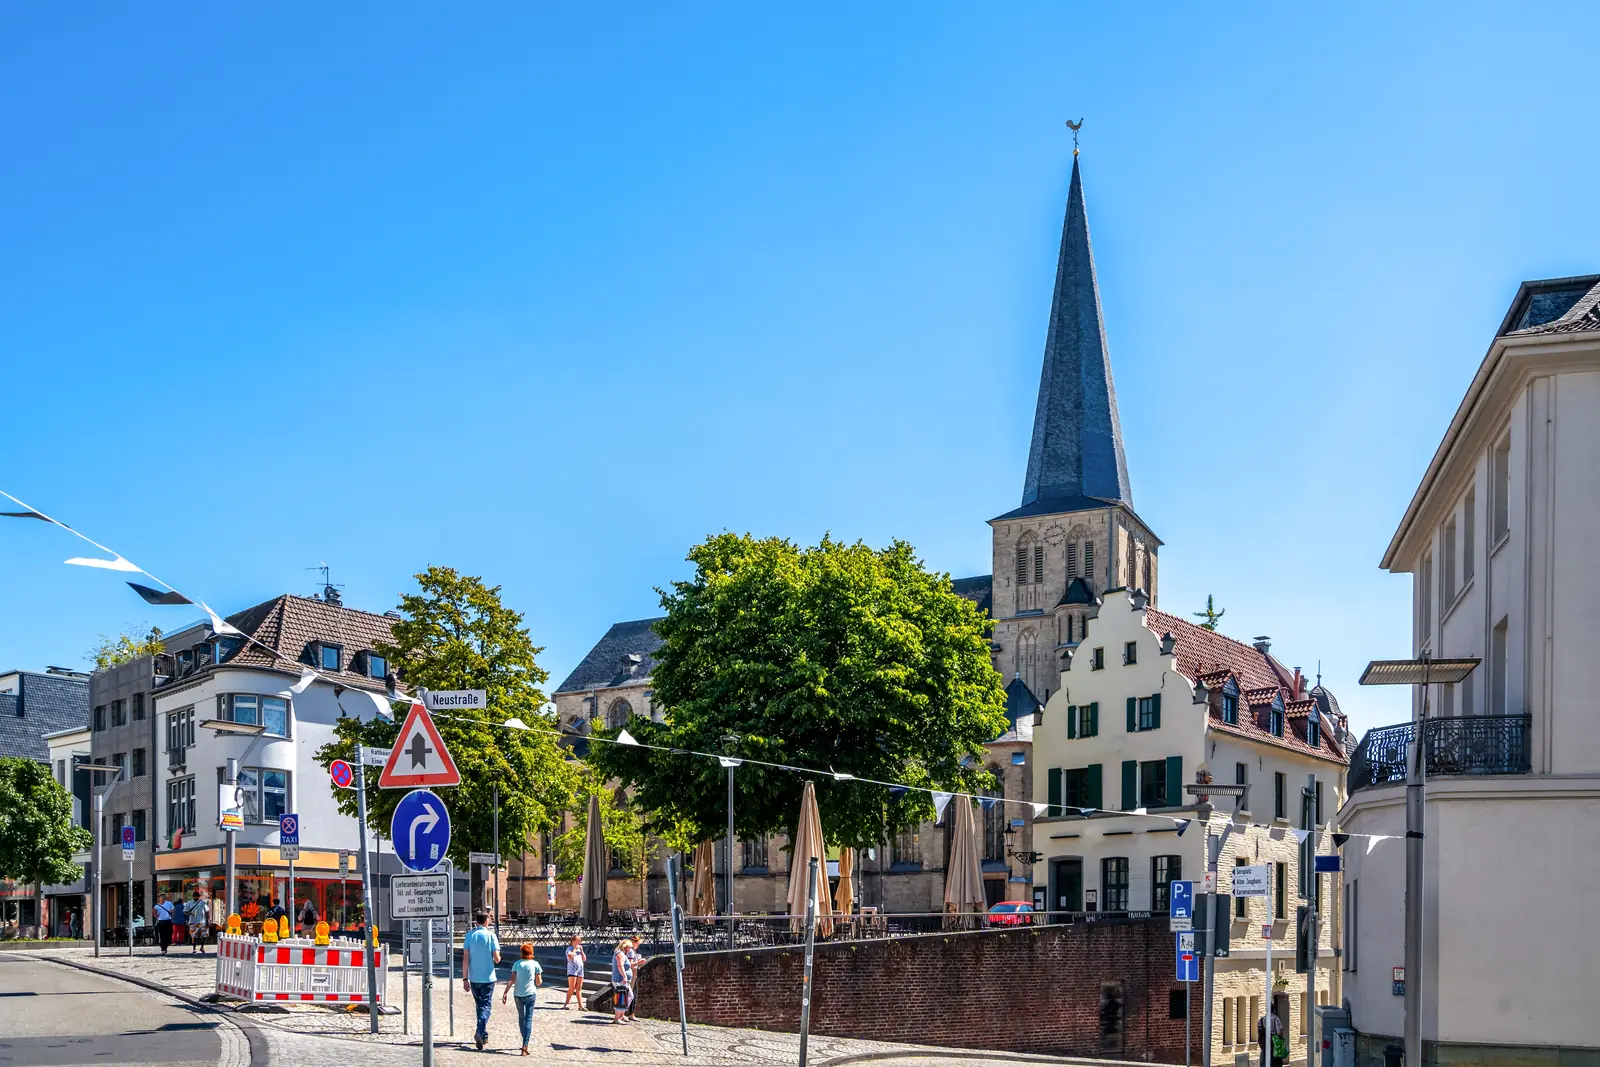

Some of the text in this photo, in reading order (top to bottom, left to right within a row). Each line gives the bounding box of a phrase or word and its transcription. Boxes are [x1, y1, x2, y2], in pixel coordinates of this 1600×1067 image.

[433, 693, 478, 705] Neustraße
[371, 757, 383, 765] Eine
[281, 836, 298, 844] TAXI
[1246, 878, 1262, 886] Zeughaus
